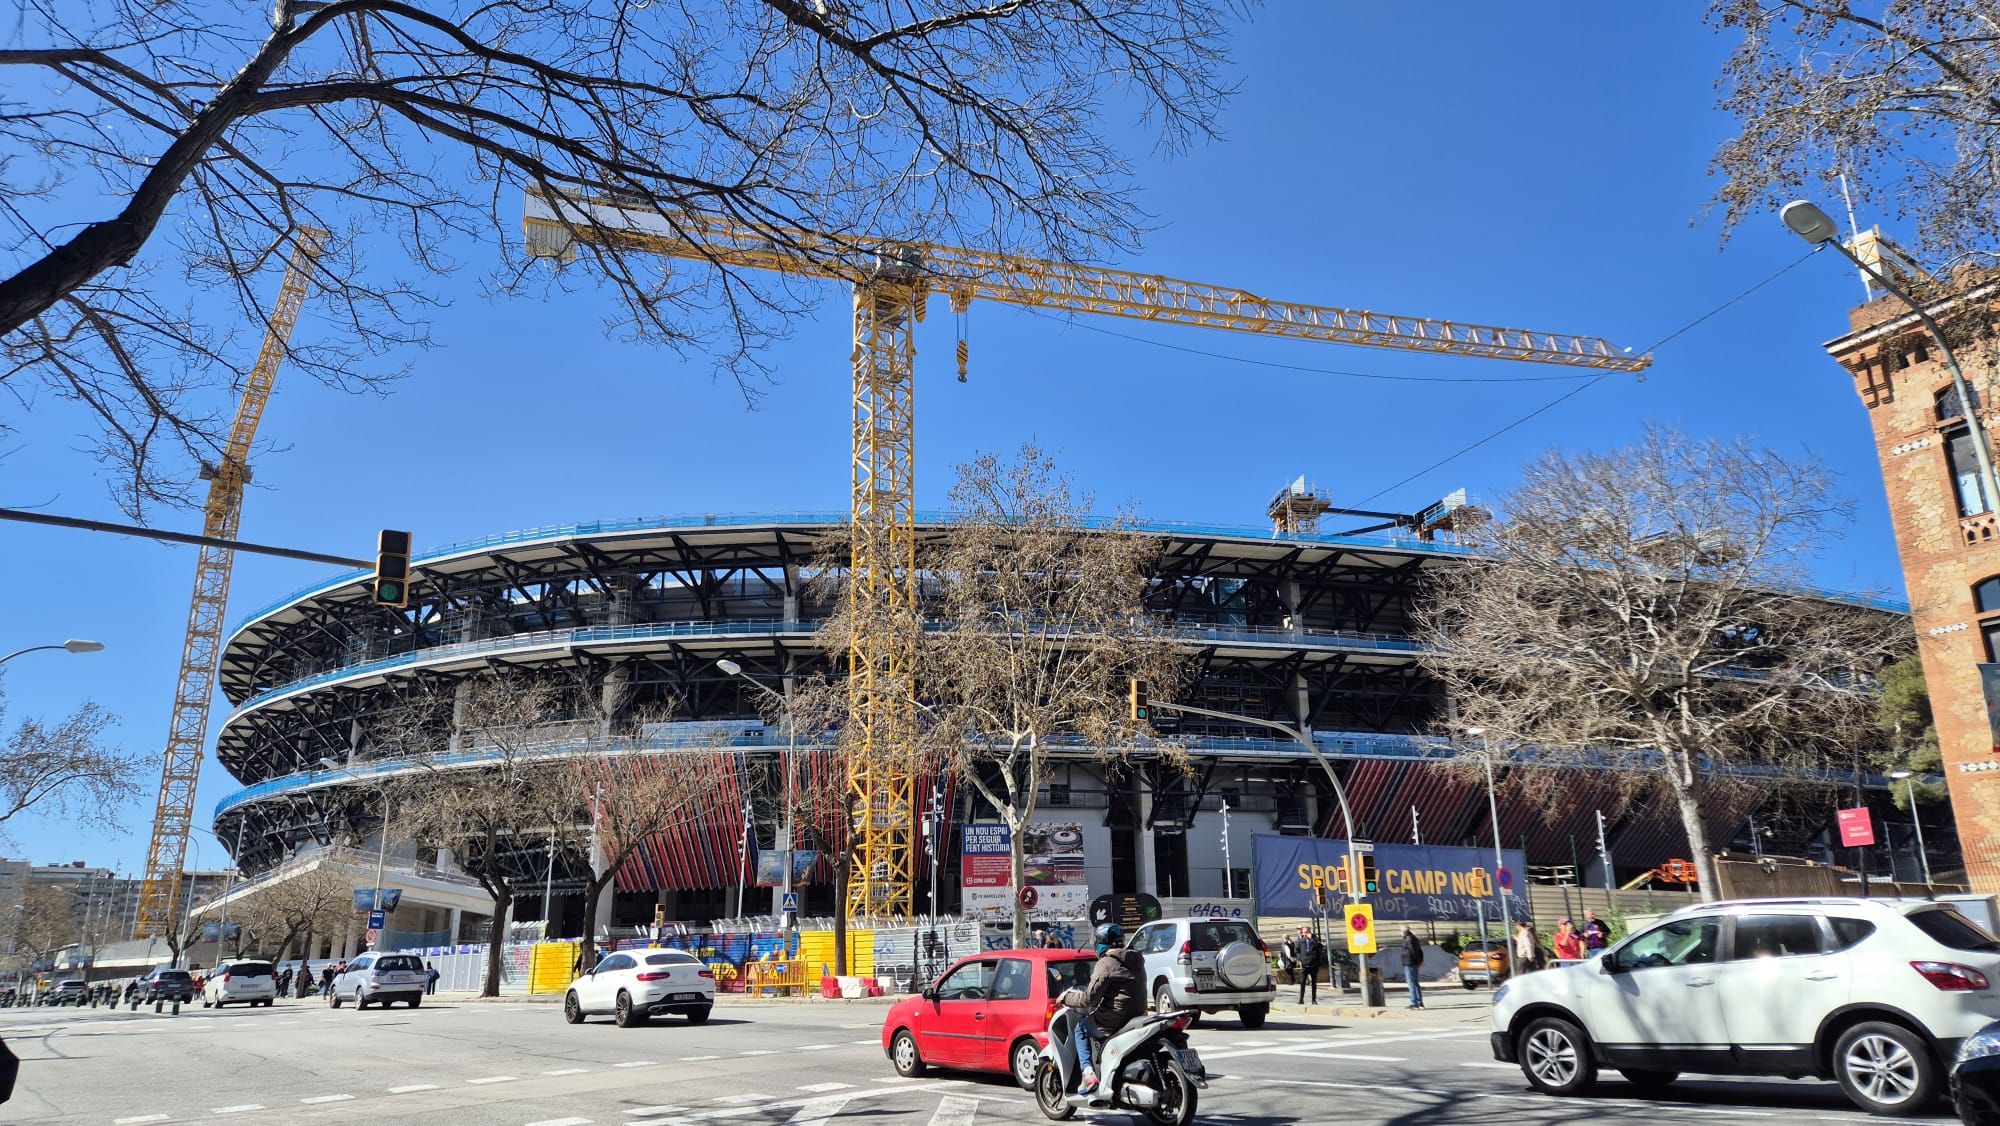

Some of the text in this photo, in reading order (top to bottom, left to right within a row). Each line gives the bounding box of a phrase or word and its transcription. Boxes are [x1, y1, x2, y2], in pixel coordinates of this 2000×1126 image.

[965, 826, 1008, 836] UN NOU ESPAI
[965, 835, 1001, 844] PER SEGUIR
[965, 844, 981, 853] FENT
[1386, 868, 1448, 895] CAMP
